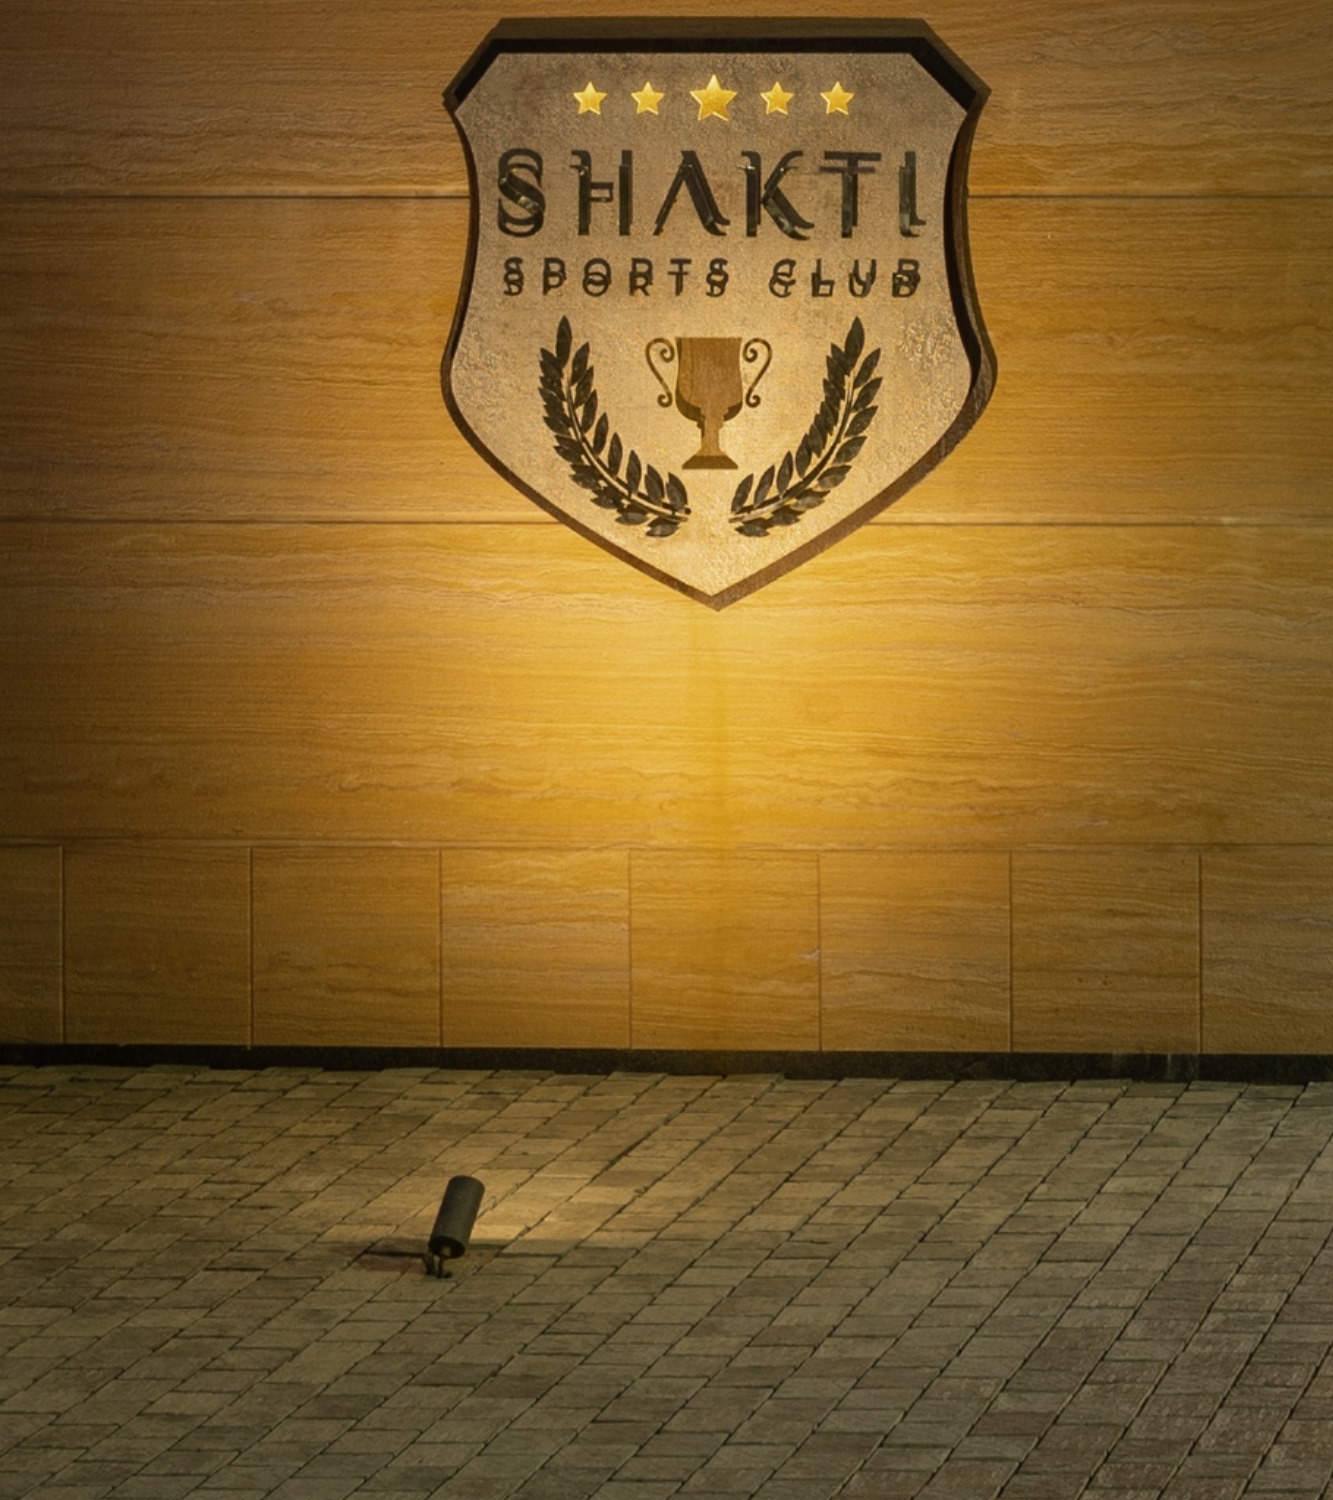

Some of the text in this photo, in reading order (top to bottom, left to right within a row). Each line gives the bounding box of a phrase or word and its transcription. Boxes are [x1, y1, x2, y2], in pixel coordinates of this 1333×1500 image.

[498, 148, 926, 240] SHAKTI
[503, 256, 921, 298] SPORTS CLUB
